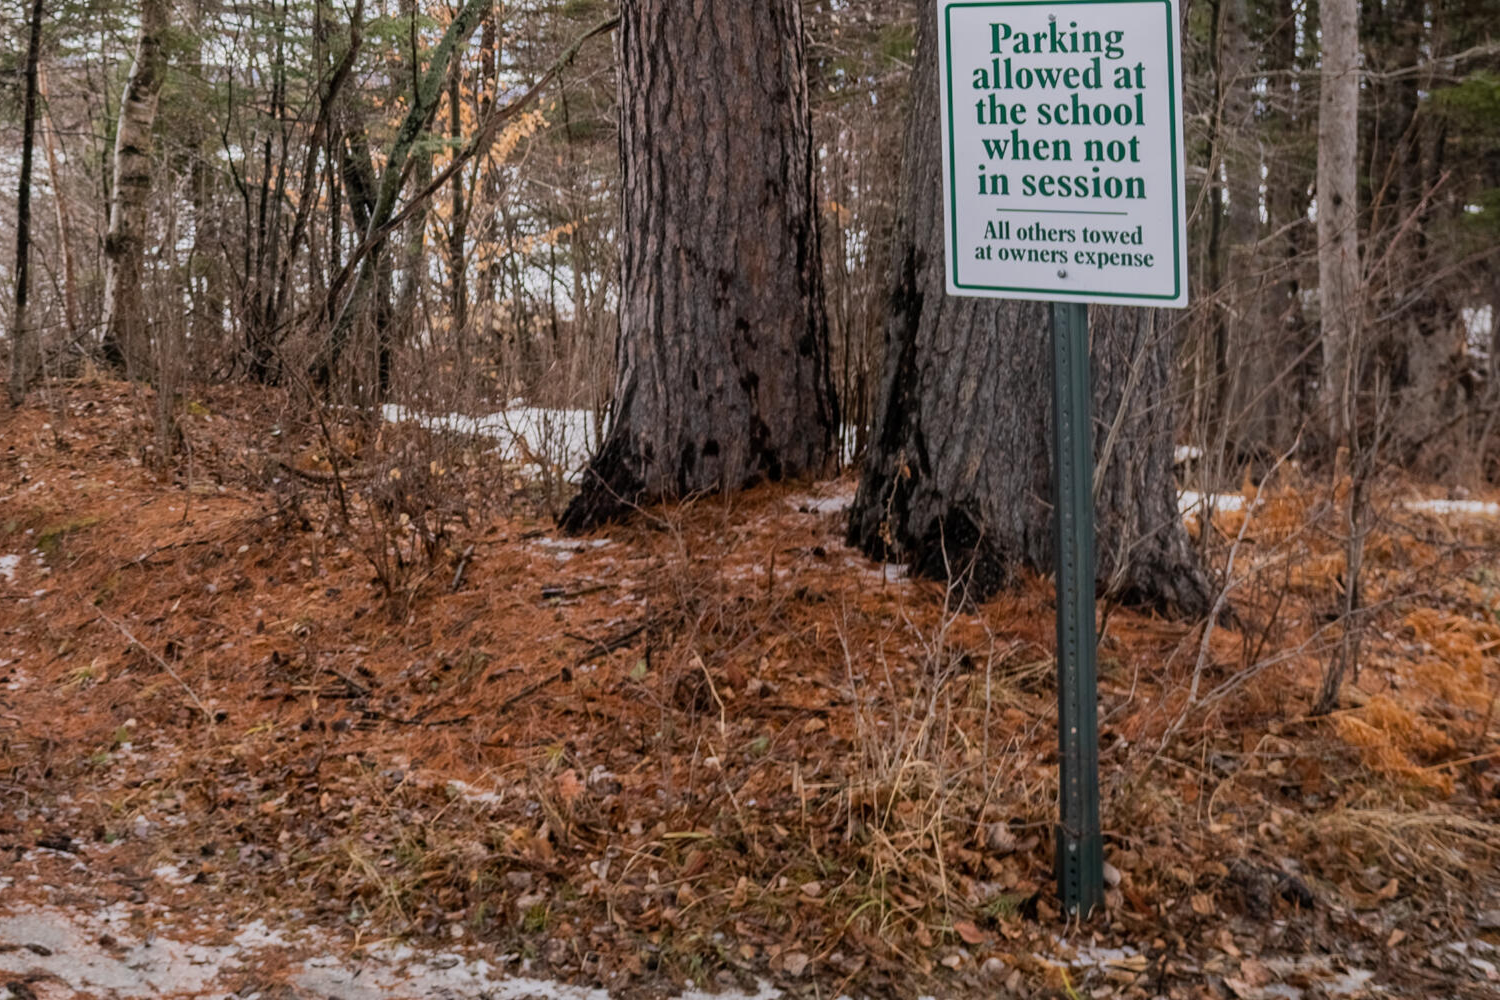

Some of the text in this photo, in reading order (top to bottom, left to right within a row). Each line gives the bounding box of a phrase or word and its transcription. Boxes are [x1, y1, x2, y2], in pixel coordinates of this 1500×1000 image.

[989, 20, 1125, 60] Parking
[972, 57, 1146, 90] allowed at
[975, 93, 1145, 126] the school
[982, 129, 1140, 163] when not
[978, 164, 1147, 199] in session
[984, 220, 1143, 245] All others towed
[974, 244, 1154, 270] at owners expense
